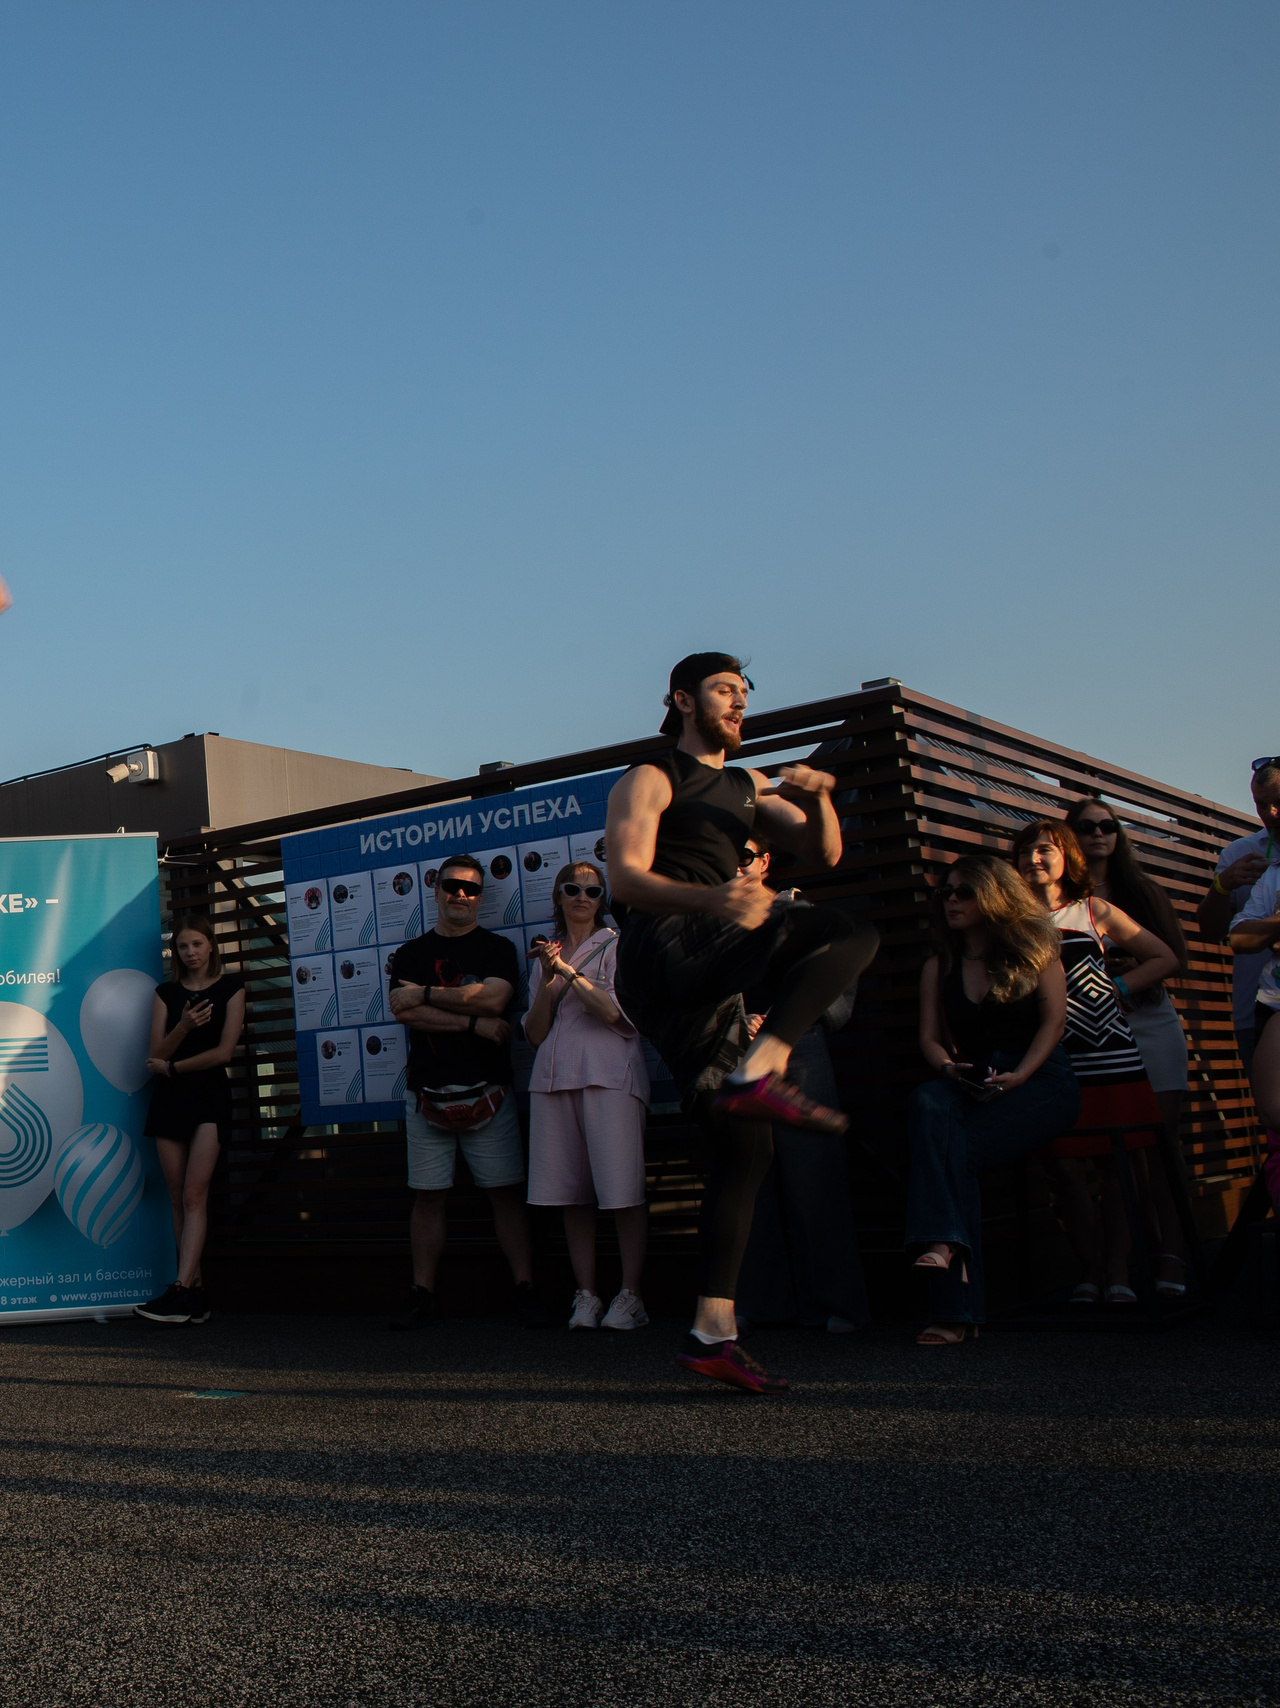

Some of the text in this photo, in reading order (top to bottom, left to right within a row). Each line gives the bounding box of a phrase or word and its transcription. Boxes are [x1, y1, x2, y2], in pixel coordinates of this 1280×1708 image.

[360, 795, 582, 854] ИСТОРИИ УСПЕХА
[58, 1273, 80, 1284] зал
[84, 1273, 92, 1282] и
[95, 1267, 152, 1281] бассейн
[0, 1296, 7, 1305] 8
[10, 1295, 37, 1305] этаж
[61, 1288, 153, 1302] www.gymatica.ru
